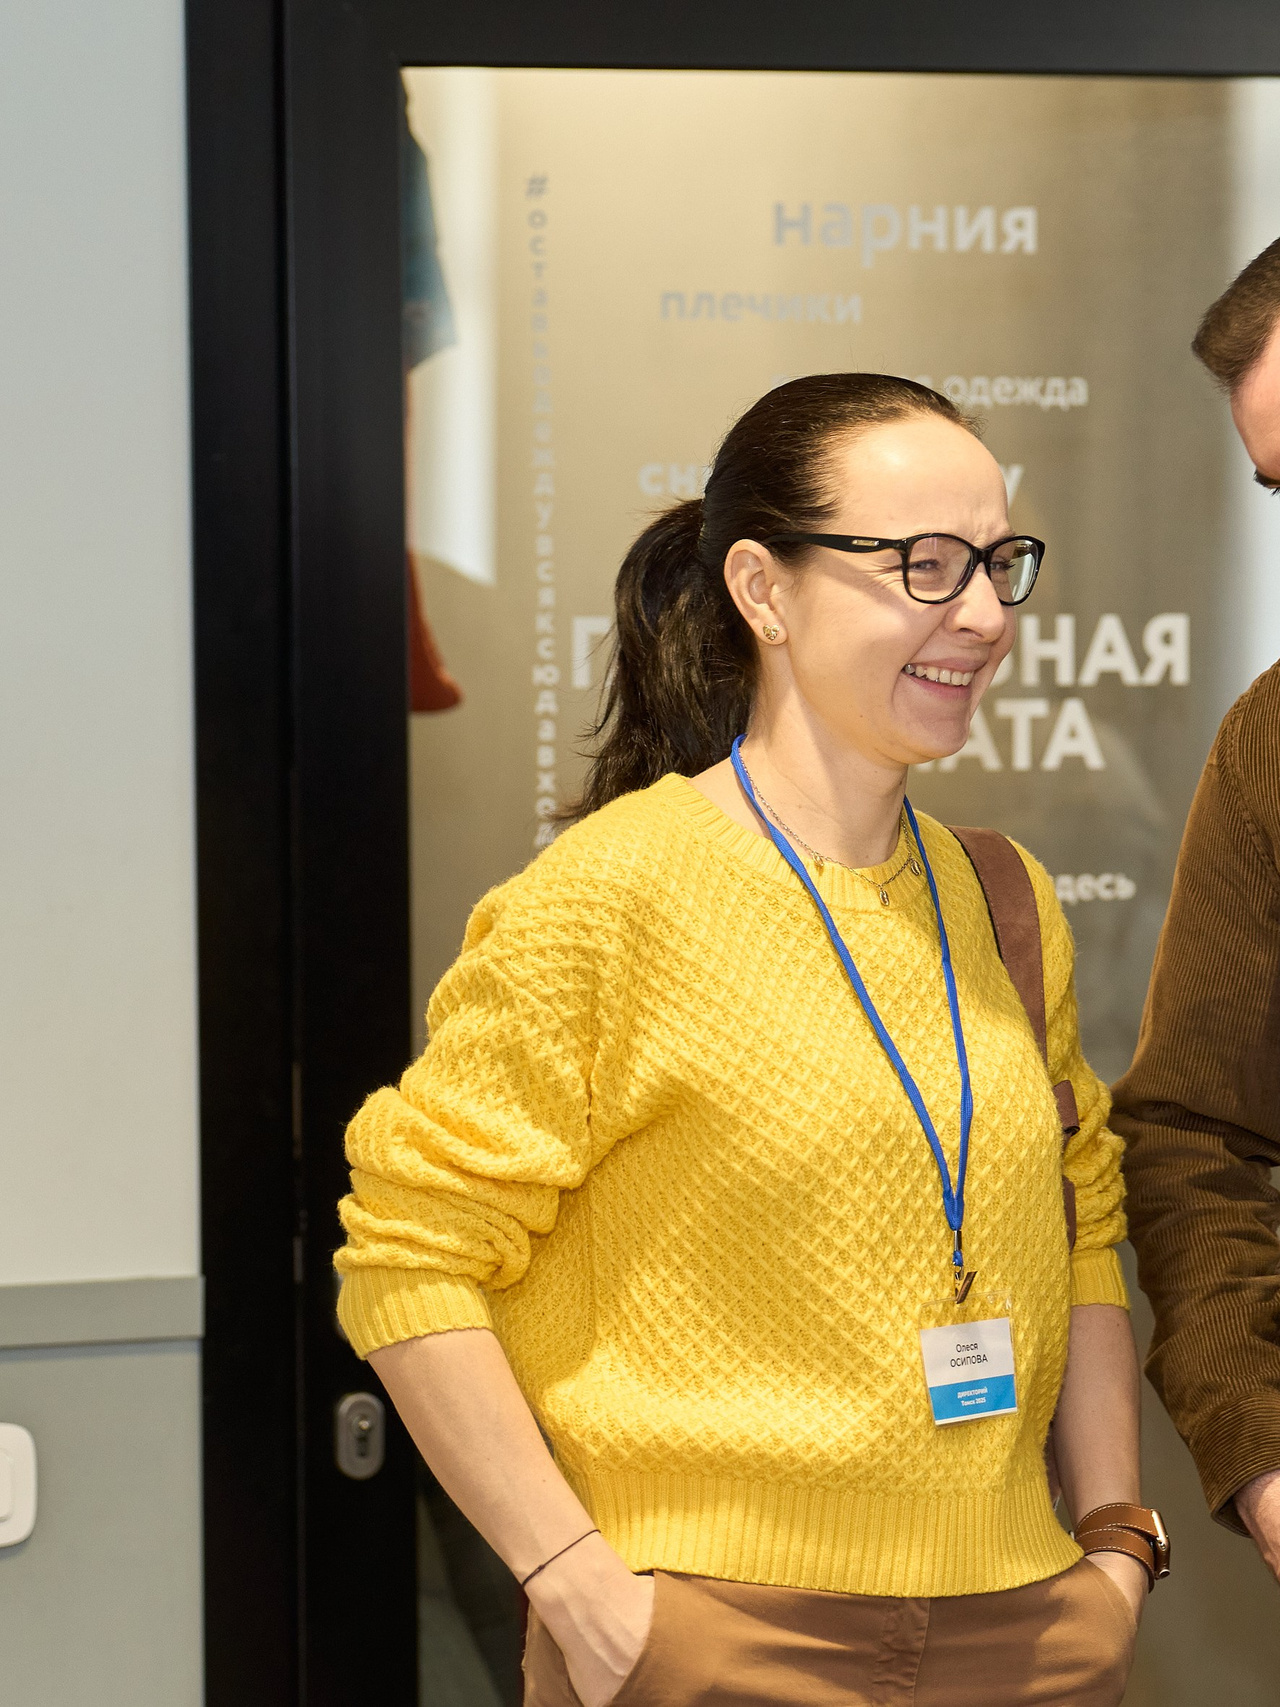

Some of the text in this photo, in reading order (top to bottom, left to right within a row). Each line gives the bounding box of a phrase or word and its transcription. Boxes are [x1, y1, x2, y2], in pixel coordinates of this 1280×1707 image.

[772, 200, 1039, 270] нарния
[660, 290, 862, 324] плечики
[943, 374, 1089, 412] одежда
[950, 1354, 988, 1367] ОСИПОВА
[956, 1343, 978, 1352] Олеся
